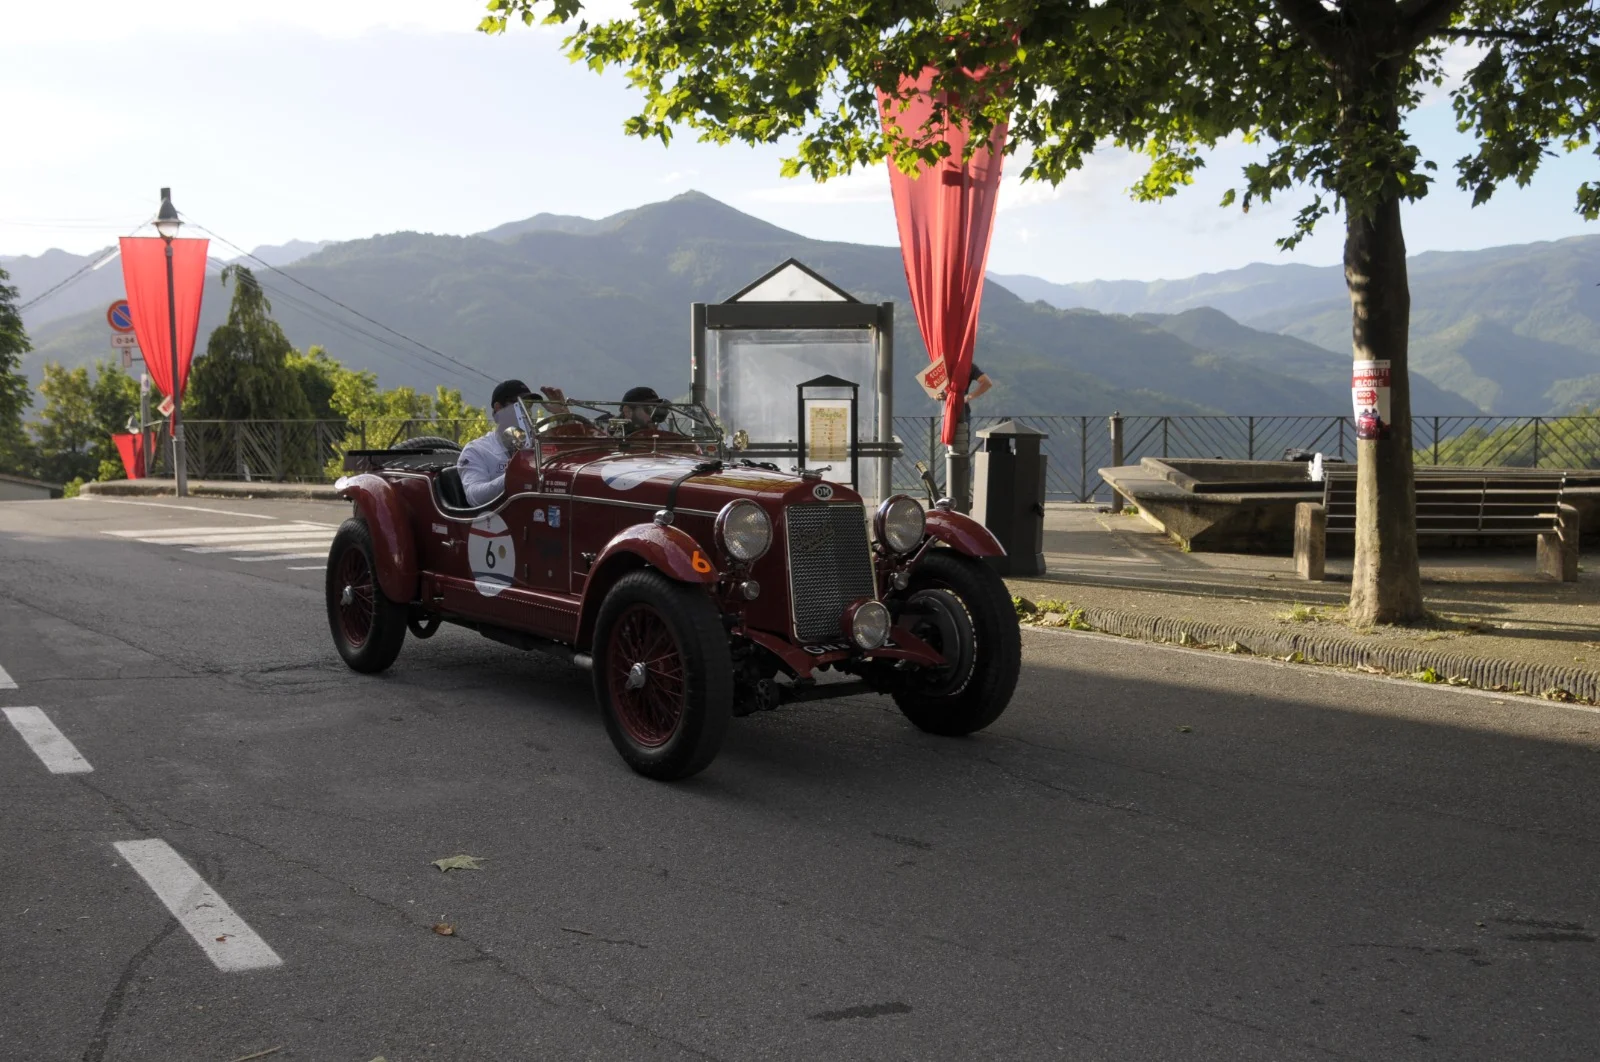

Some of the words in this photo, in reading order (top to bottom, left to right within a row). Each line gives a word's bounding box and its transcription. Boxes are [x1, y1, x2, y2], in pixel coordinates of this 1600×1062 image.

[1353, 369, 1389, 377] VENUTI
[816, 487, 830, 497] OM
[486, 541, 496, 569] 6
[691, 550, 712, 573] 6
